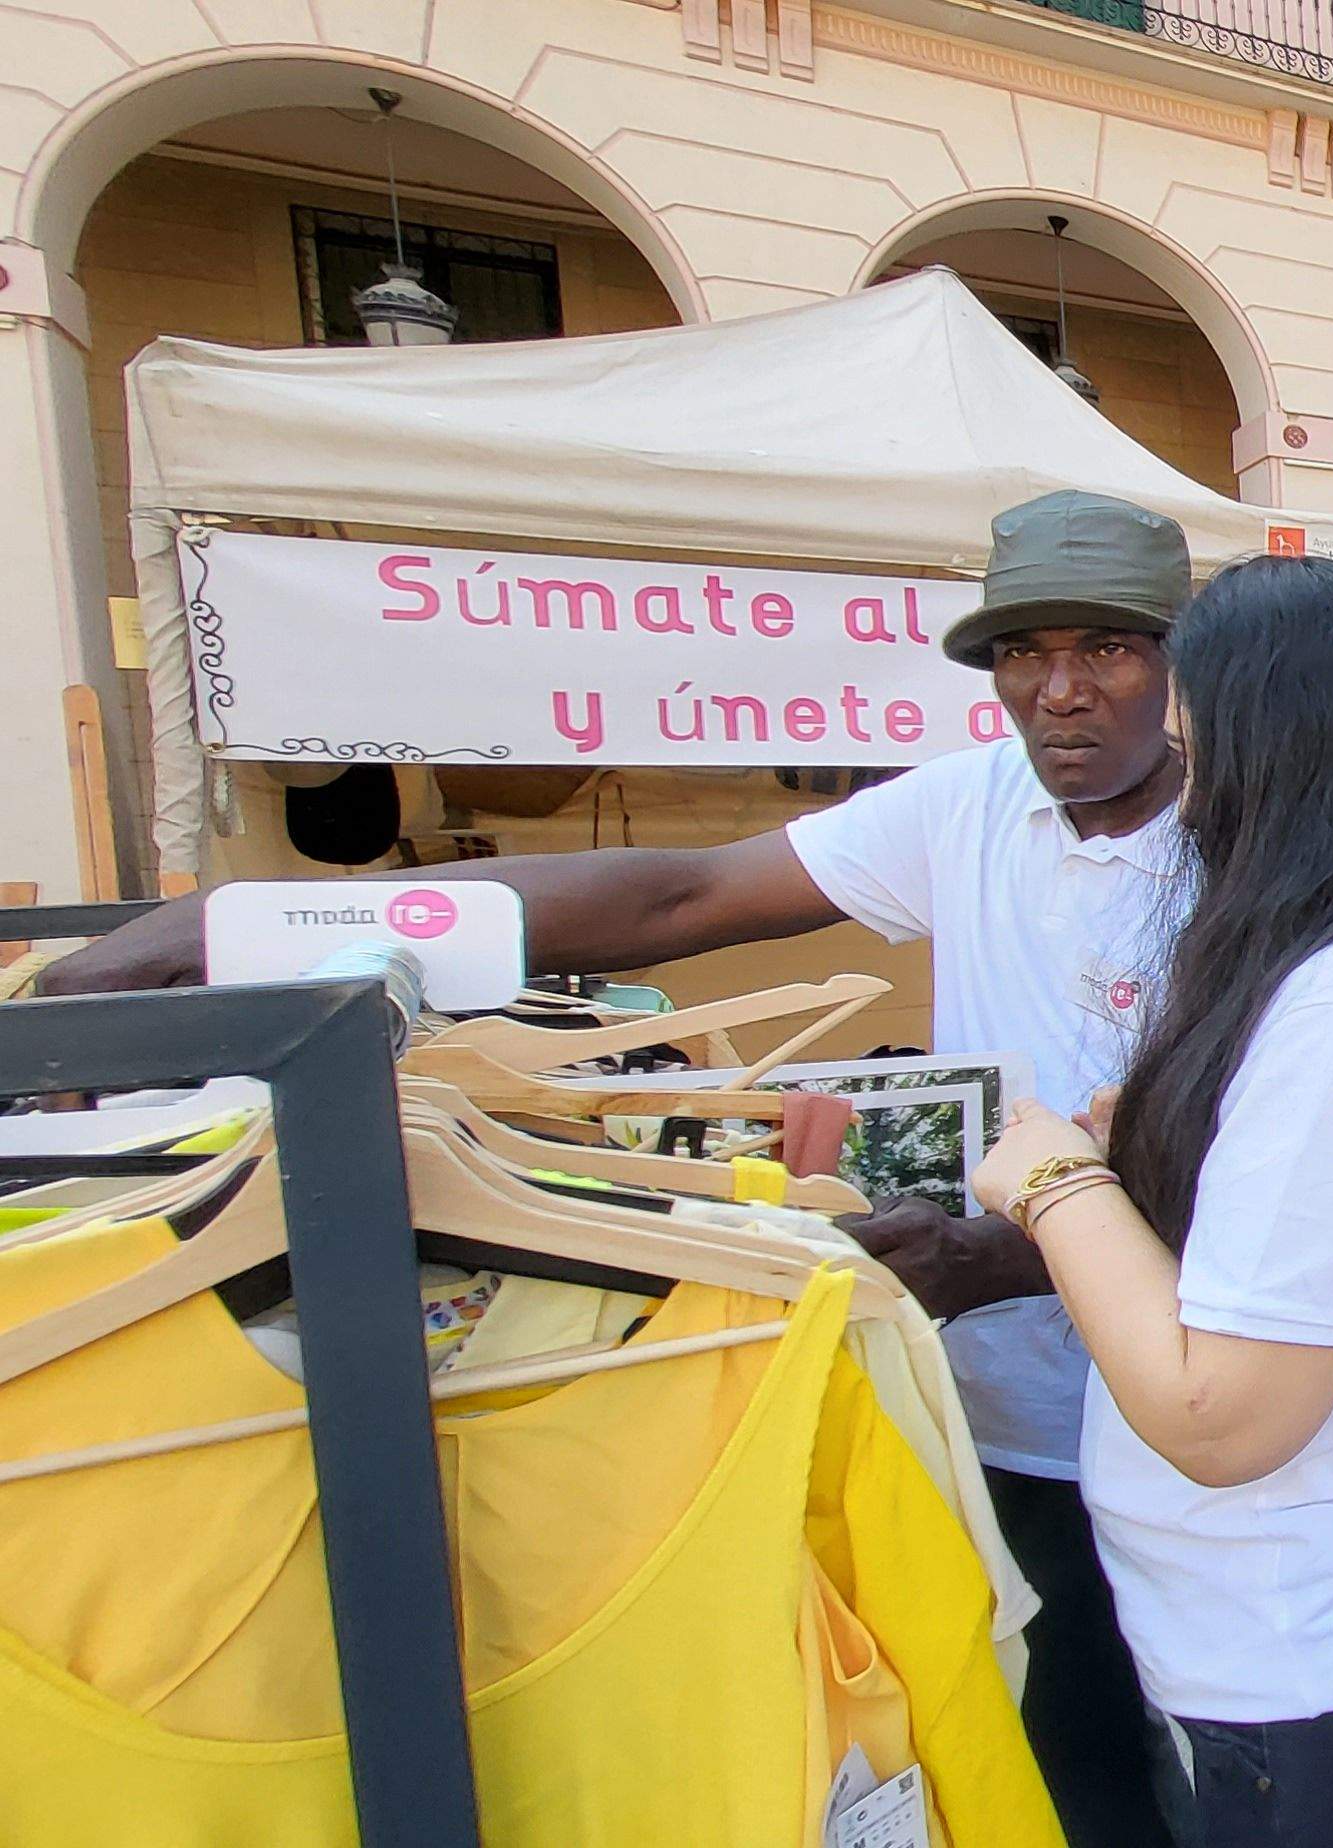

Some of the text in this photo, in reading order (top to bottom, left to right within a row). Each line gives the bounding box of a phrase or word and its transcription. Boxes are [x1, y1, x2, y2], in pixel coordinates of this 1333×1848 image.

[377, 554, 930, 645] Súmate al
[551, 690, 605, 753] y
[656, 680, 926, 744] únete
[282, 904, 379, 926] moda
